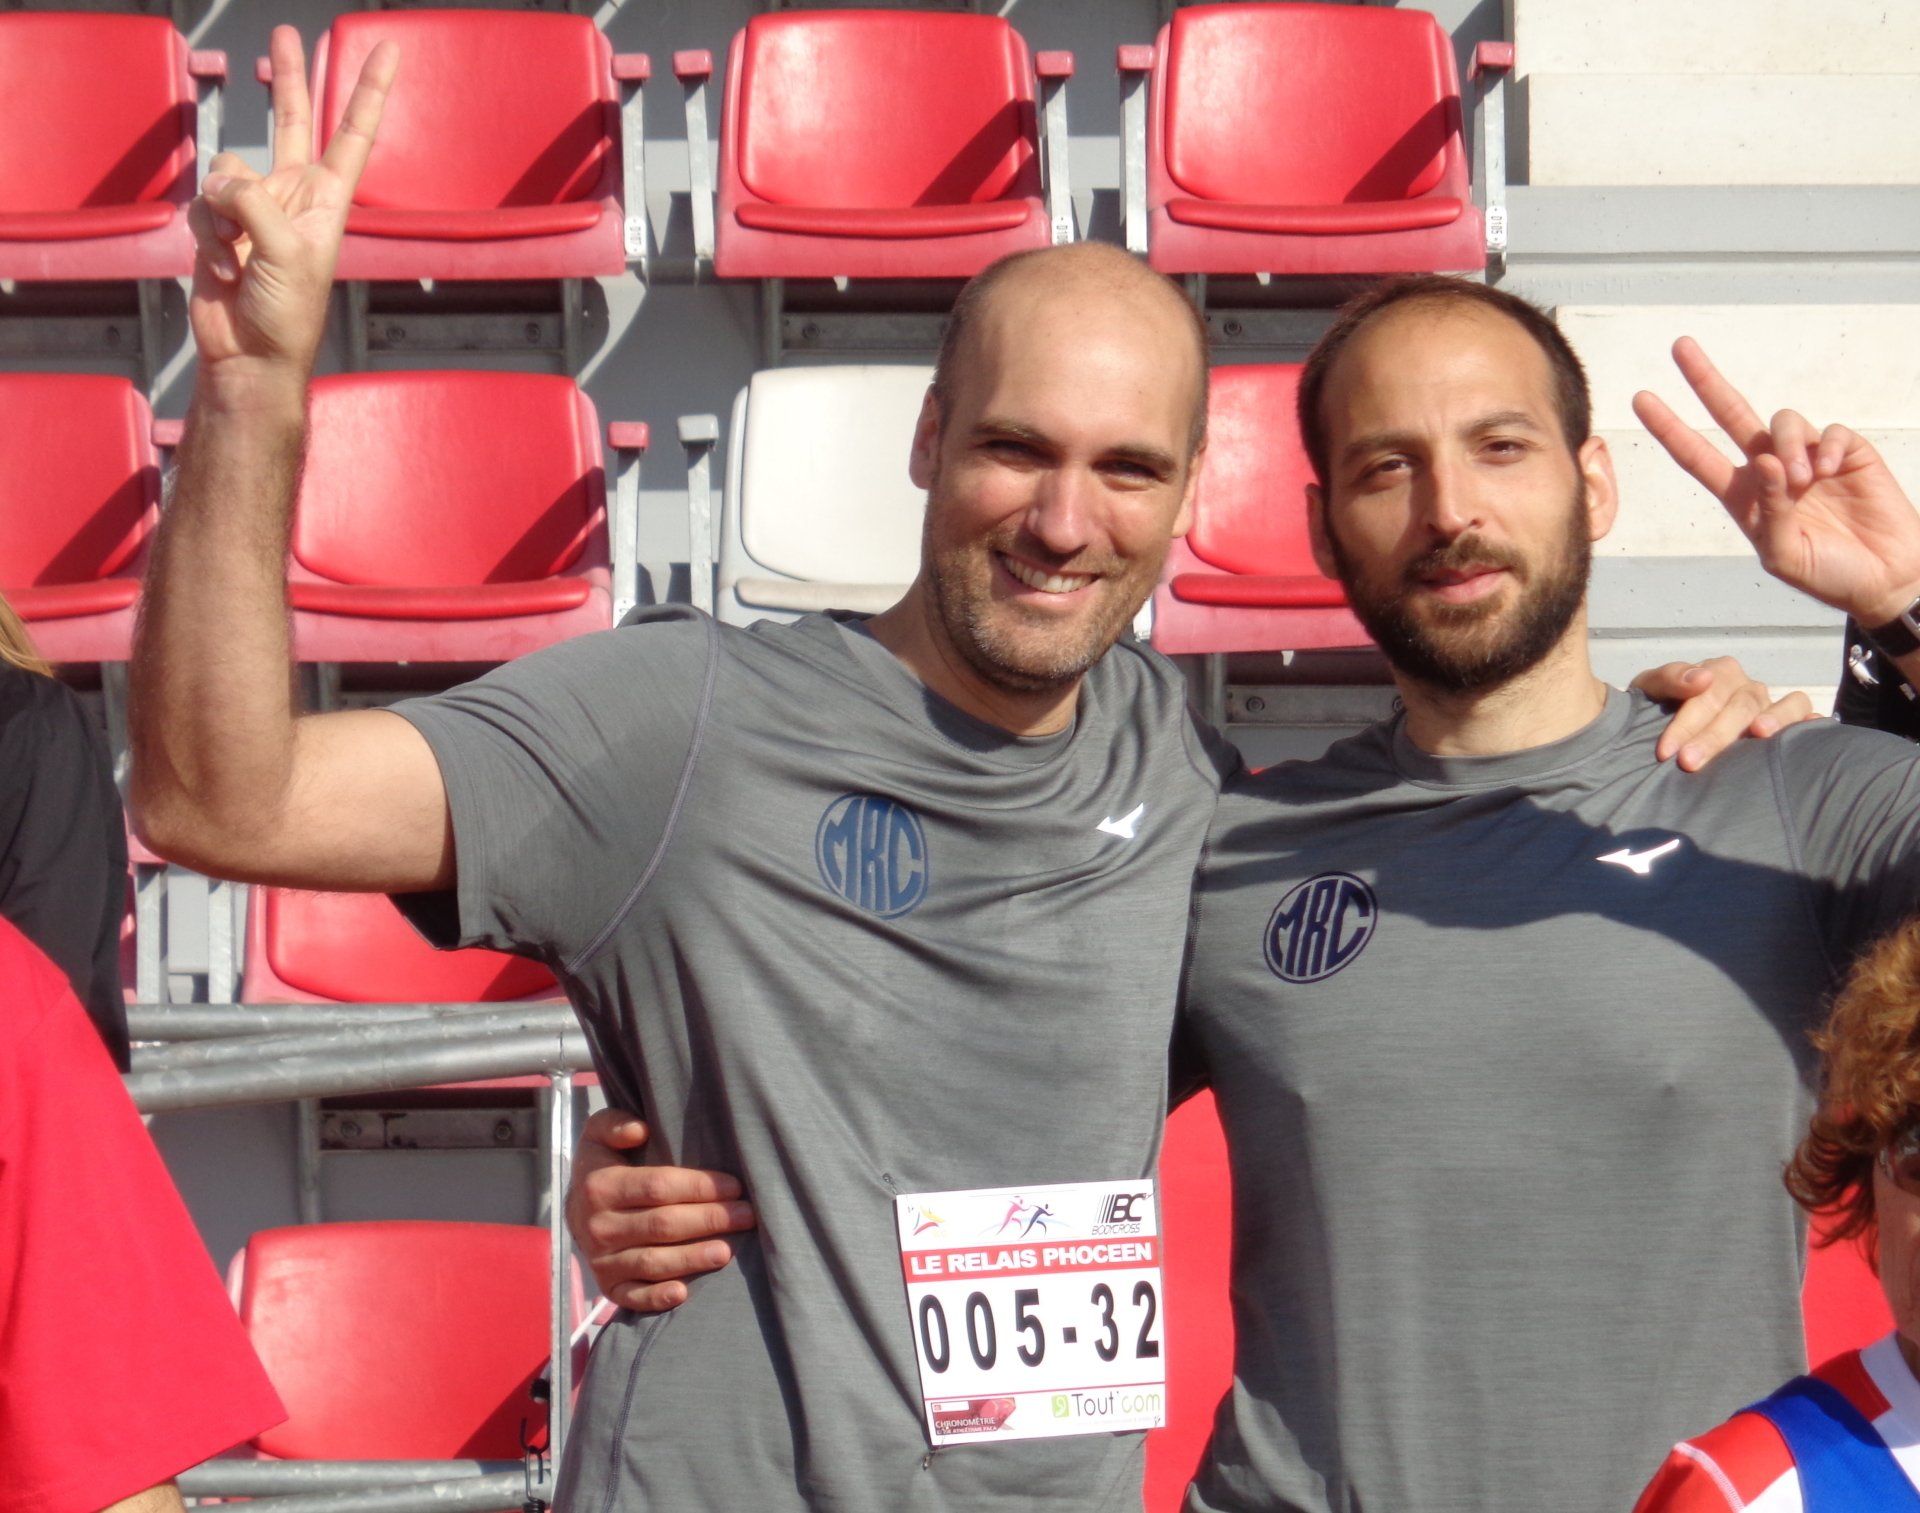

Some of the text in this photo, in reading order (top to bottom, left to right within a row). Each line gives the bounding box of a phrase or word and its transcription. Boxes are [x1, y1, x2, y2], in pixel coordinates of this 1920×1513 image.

[822, 796, 923, 914] MRC
[1270, 876, 1373, 978] MRC
[911, 1242, 1152, 1275] LE RELAIS PHOCEEN
[1092, 1223, 1141, 1235] BODYCROSS
[919, 1281, 1159, 1373] 005-32
[935, 1417, 996, 1428] CHRONOMÉTRIE
